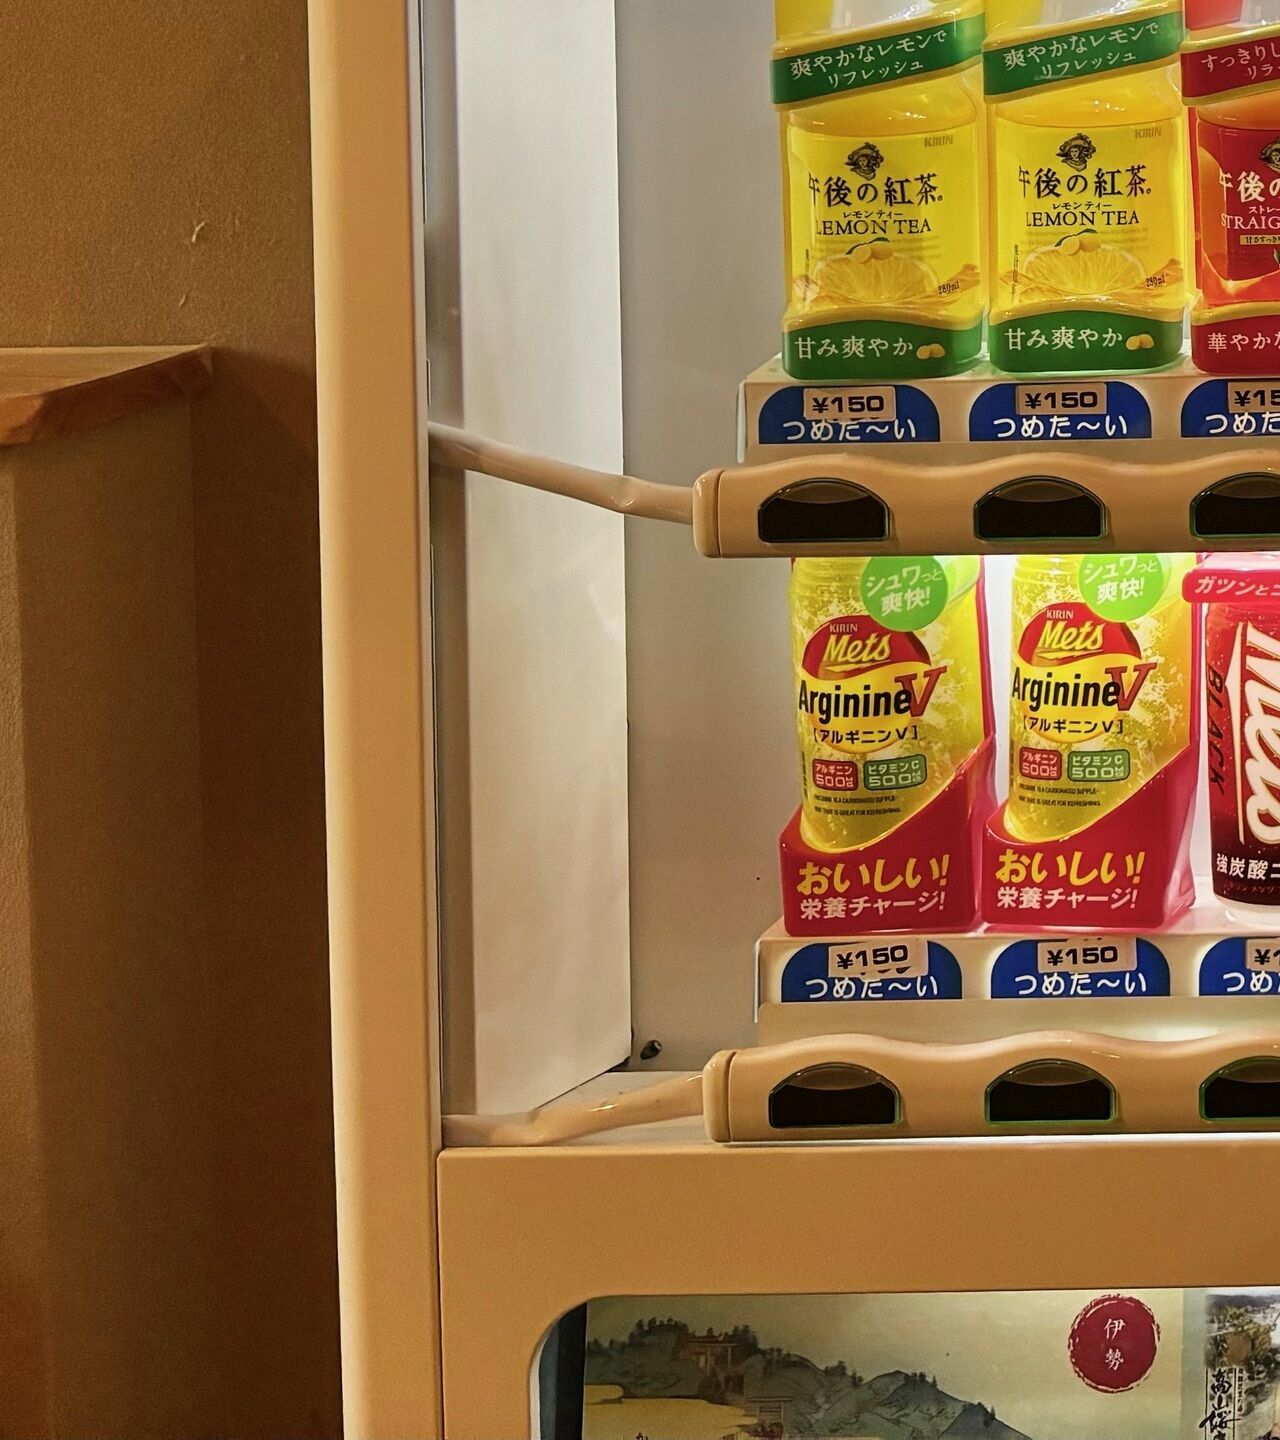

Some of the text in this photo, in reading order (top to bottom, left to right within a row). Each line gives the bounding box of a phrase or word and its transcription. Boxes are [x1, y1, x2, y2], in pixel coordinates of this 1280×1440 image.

[790, 29, 947, 80] 爽やかなレモンで
[827, 60, 924, 89] リフレッシュ
[924, 135, 953, 147] KIRIN
[1025, 210, 1140, 227] LEMON TEA
[794, 336, 913, 359] 甘み爽やか
[812, 396, 884, 413] ¥150
[1025, 392, 1098, 408] ¥150
[830, 623, 858, 634] KIRIN
[1040, 619, 1105, 656] Mets
[824, 633, 892, 668] Mets
[797, 855, 950, 895] おいしい!
[1047, 946, 1118, 966] ¥150
[1104, 1319, 1125, 1371] 伊勢
